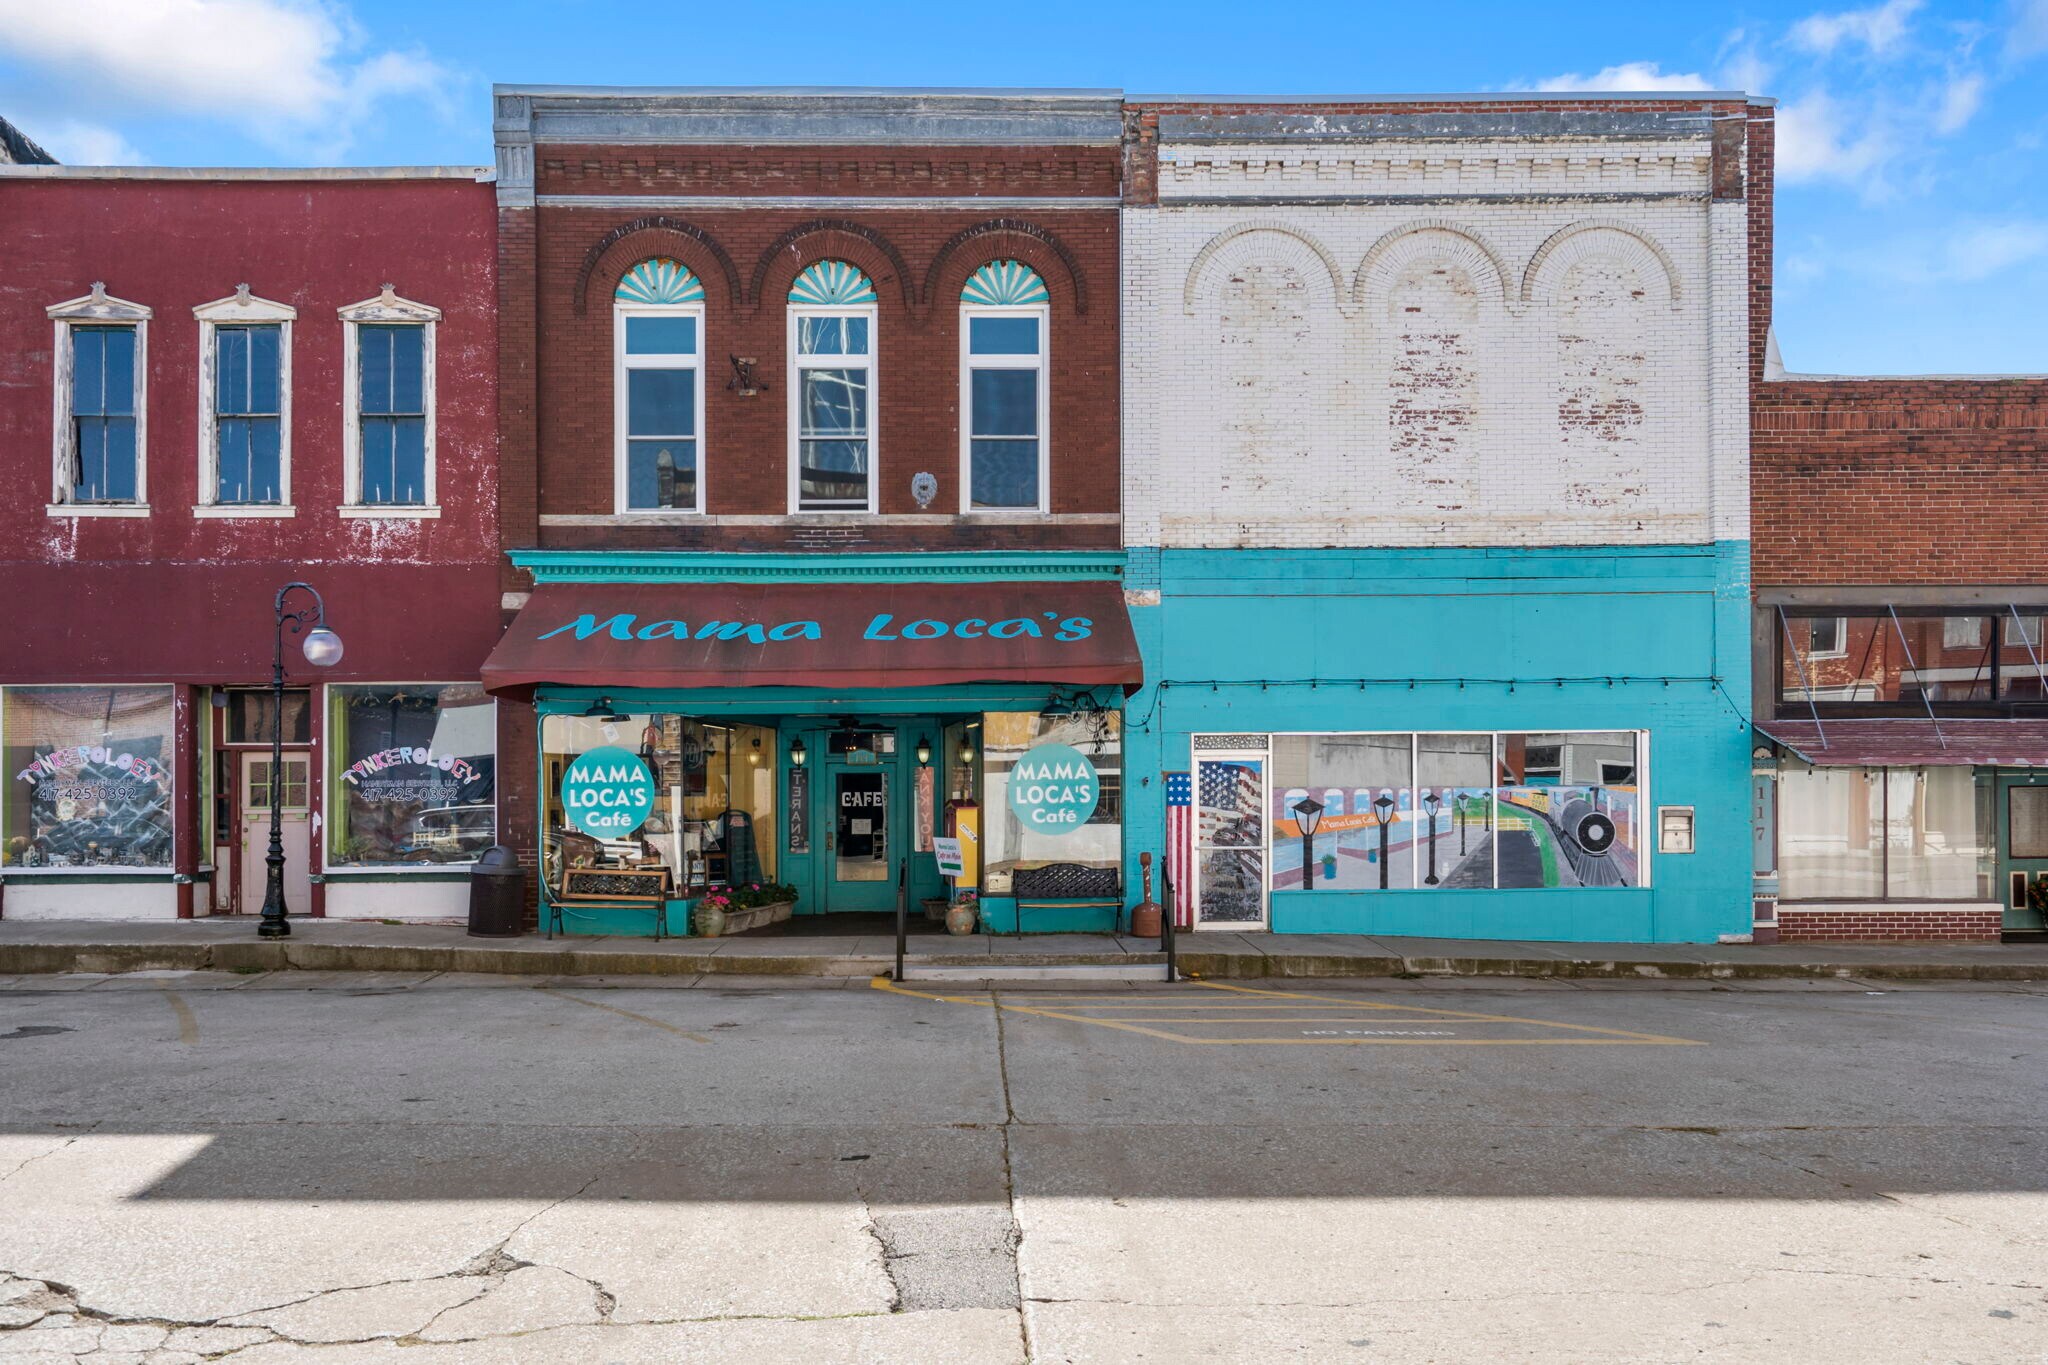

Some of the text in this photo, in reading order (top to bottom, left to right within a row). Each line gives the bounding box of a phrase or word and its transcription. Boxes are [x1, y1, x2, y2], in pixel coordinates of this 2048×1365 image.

[537, 611, 1093, 643] Mama Loca's
[16, 746, 160, 784] TINKEROLOGY
[339, 747, 481, 785] TINKEROLOGY
[570, 765, 646, 783] MAMA
[1016, 762, 1091, 780] MAMA
[39, 787, 137, 800] 417-425-0392
[360, 788, 458, 801] 417-425-0392
[570, 788, 647, 807] LOCA'S
[841, 791, 883, 807] CAFE
[1016, 785, 1091, 804] LOCA'S
[585, 811, 632, 826] Café
[1031, 808, 1077, 823] Café
